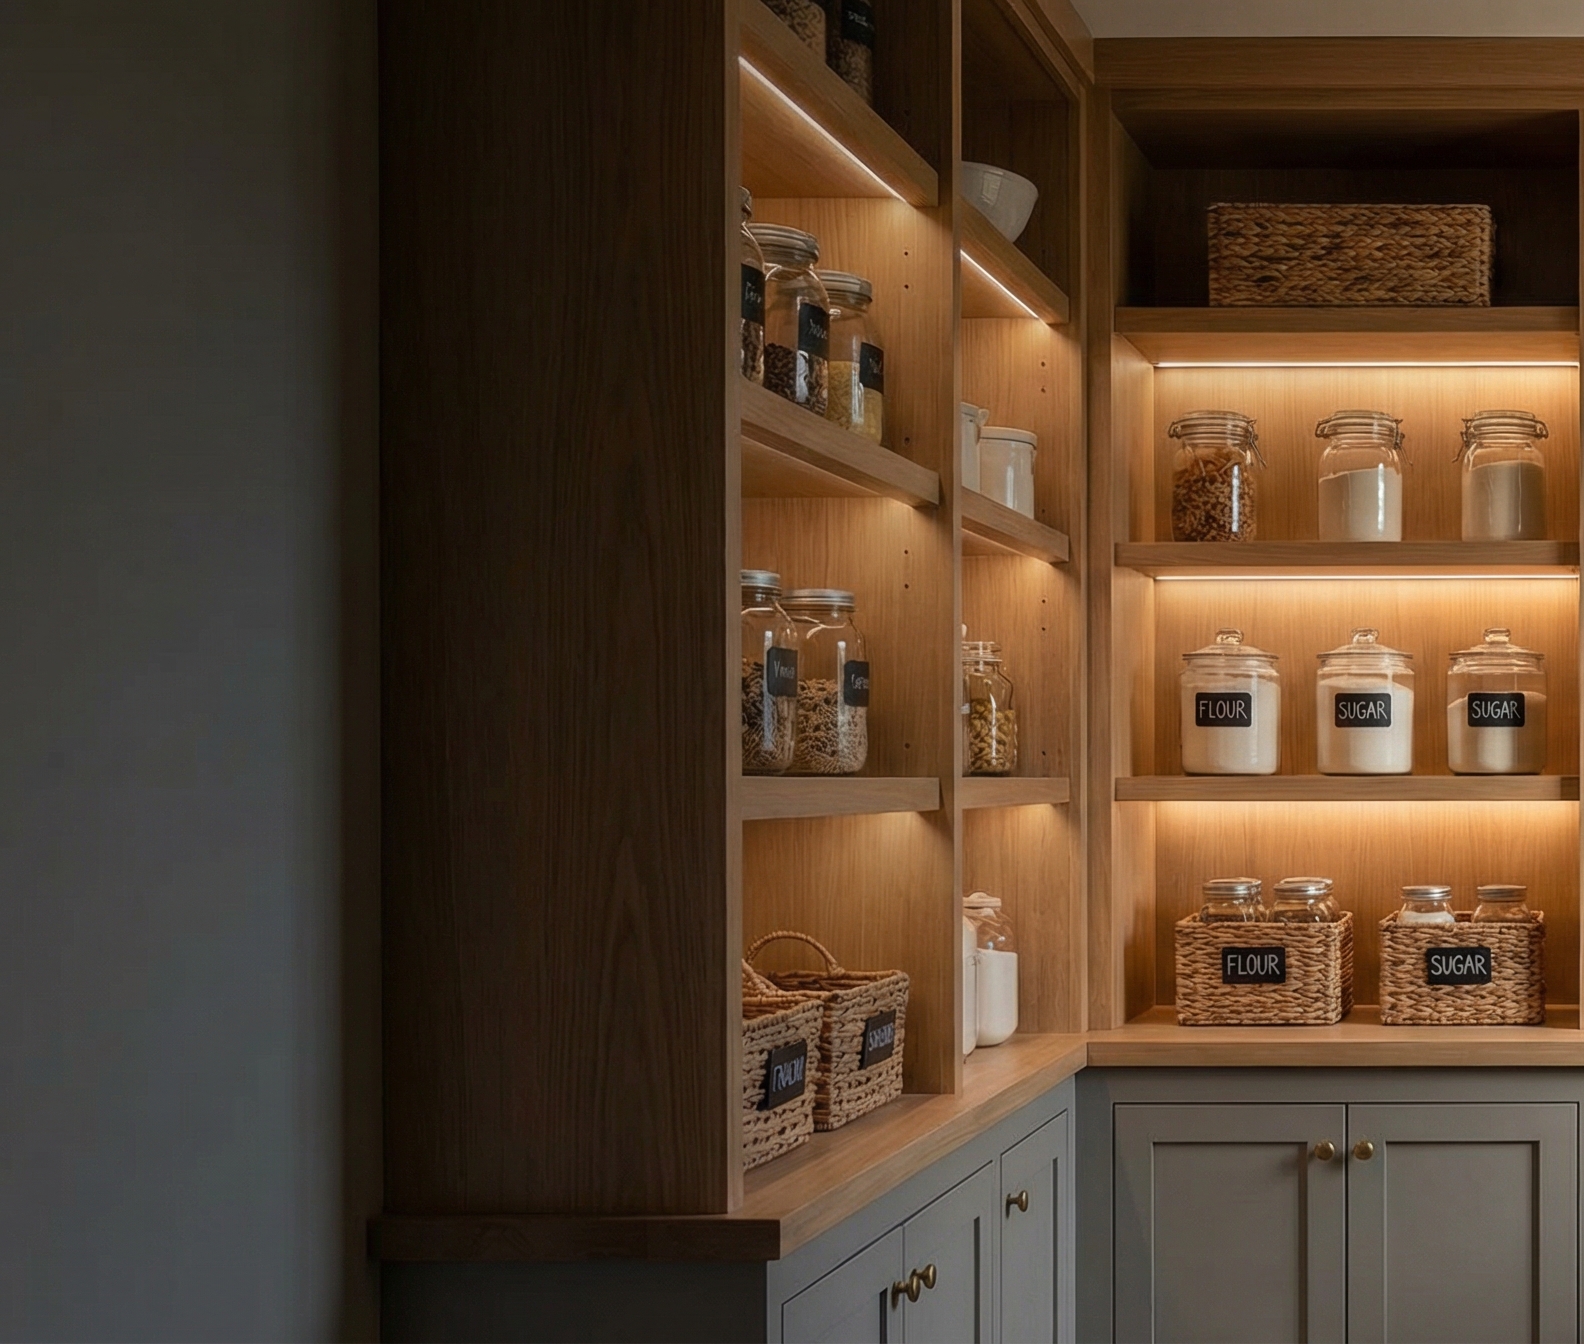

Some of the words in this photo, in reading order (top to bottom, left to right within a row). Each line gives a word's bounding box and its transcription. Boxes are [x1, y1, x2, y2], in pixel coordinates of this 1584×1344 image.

[1199, 700, 1248, 720] FLOUR
[1338, 700, 1388, 720] SUGAR
[1471, 700, 1521, 719] SUGAR
[1227, 954, 1280, 976] FLOUR
[1430, 954, 1488, 976] SUGAR
